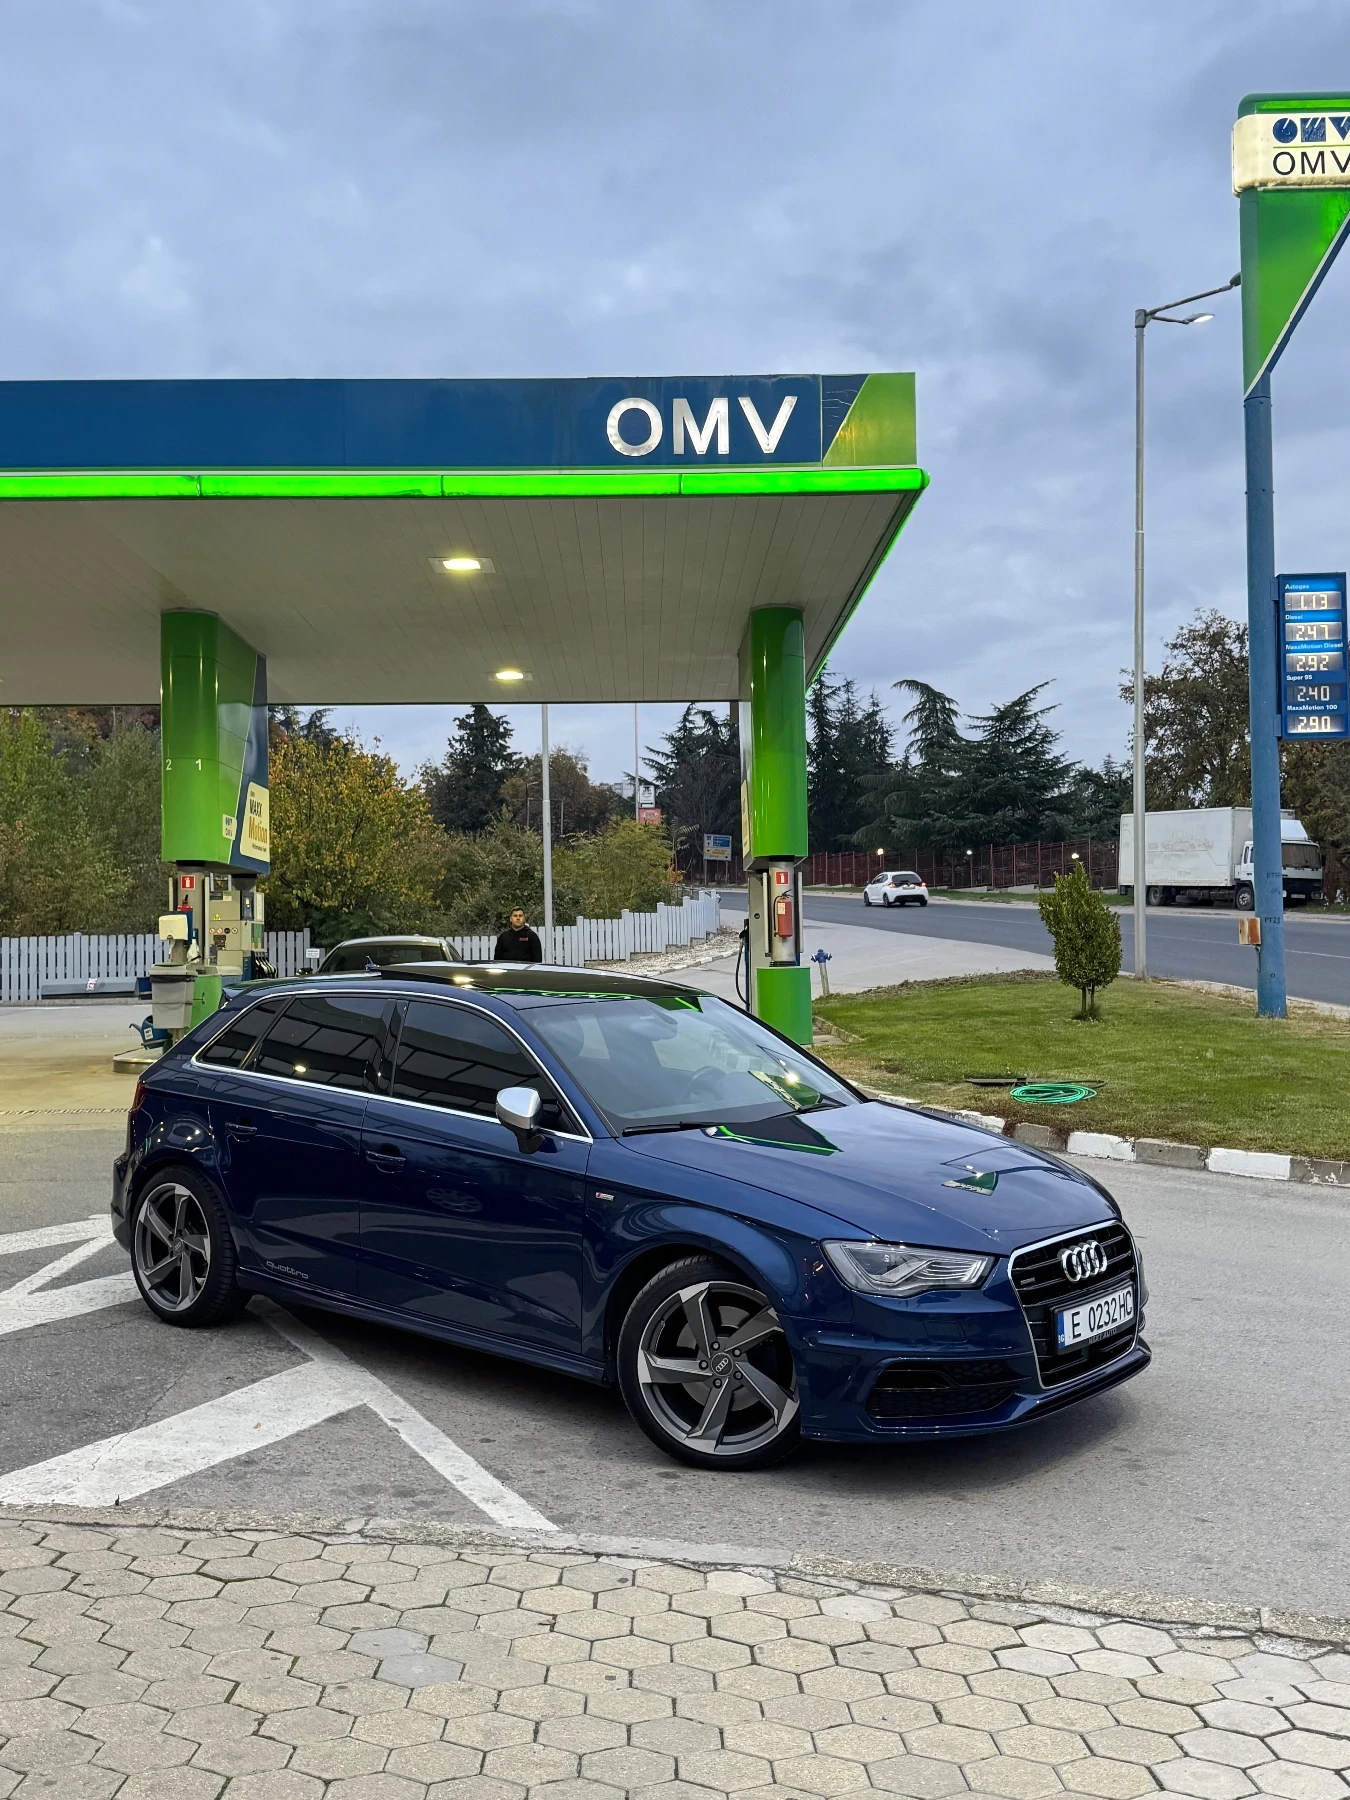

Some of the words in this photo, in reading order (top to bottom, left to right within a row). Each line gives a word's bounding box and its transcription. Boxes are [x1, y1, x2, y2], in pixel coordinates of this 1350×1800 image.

[1272, 150, 1350, 176] OMV
[606, 395, 798, 457] OMV
[1300, 594, 1328, 610] 1.13
[1295, 624, 1329, 641] 2.47
[1296, 655, 1329, 671] 2.92
[1297, 685, 1330, 702] 2.40
[1297, 715, 1331, 732] 2.90
[165, 758, 173, 771] 2
[195, 758, 202, 771] 1
[266, 1260, 309, 1279] quattro
[1071, 1310, 1082, 1340] E
